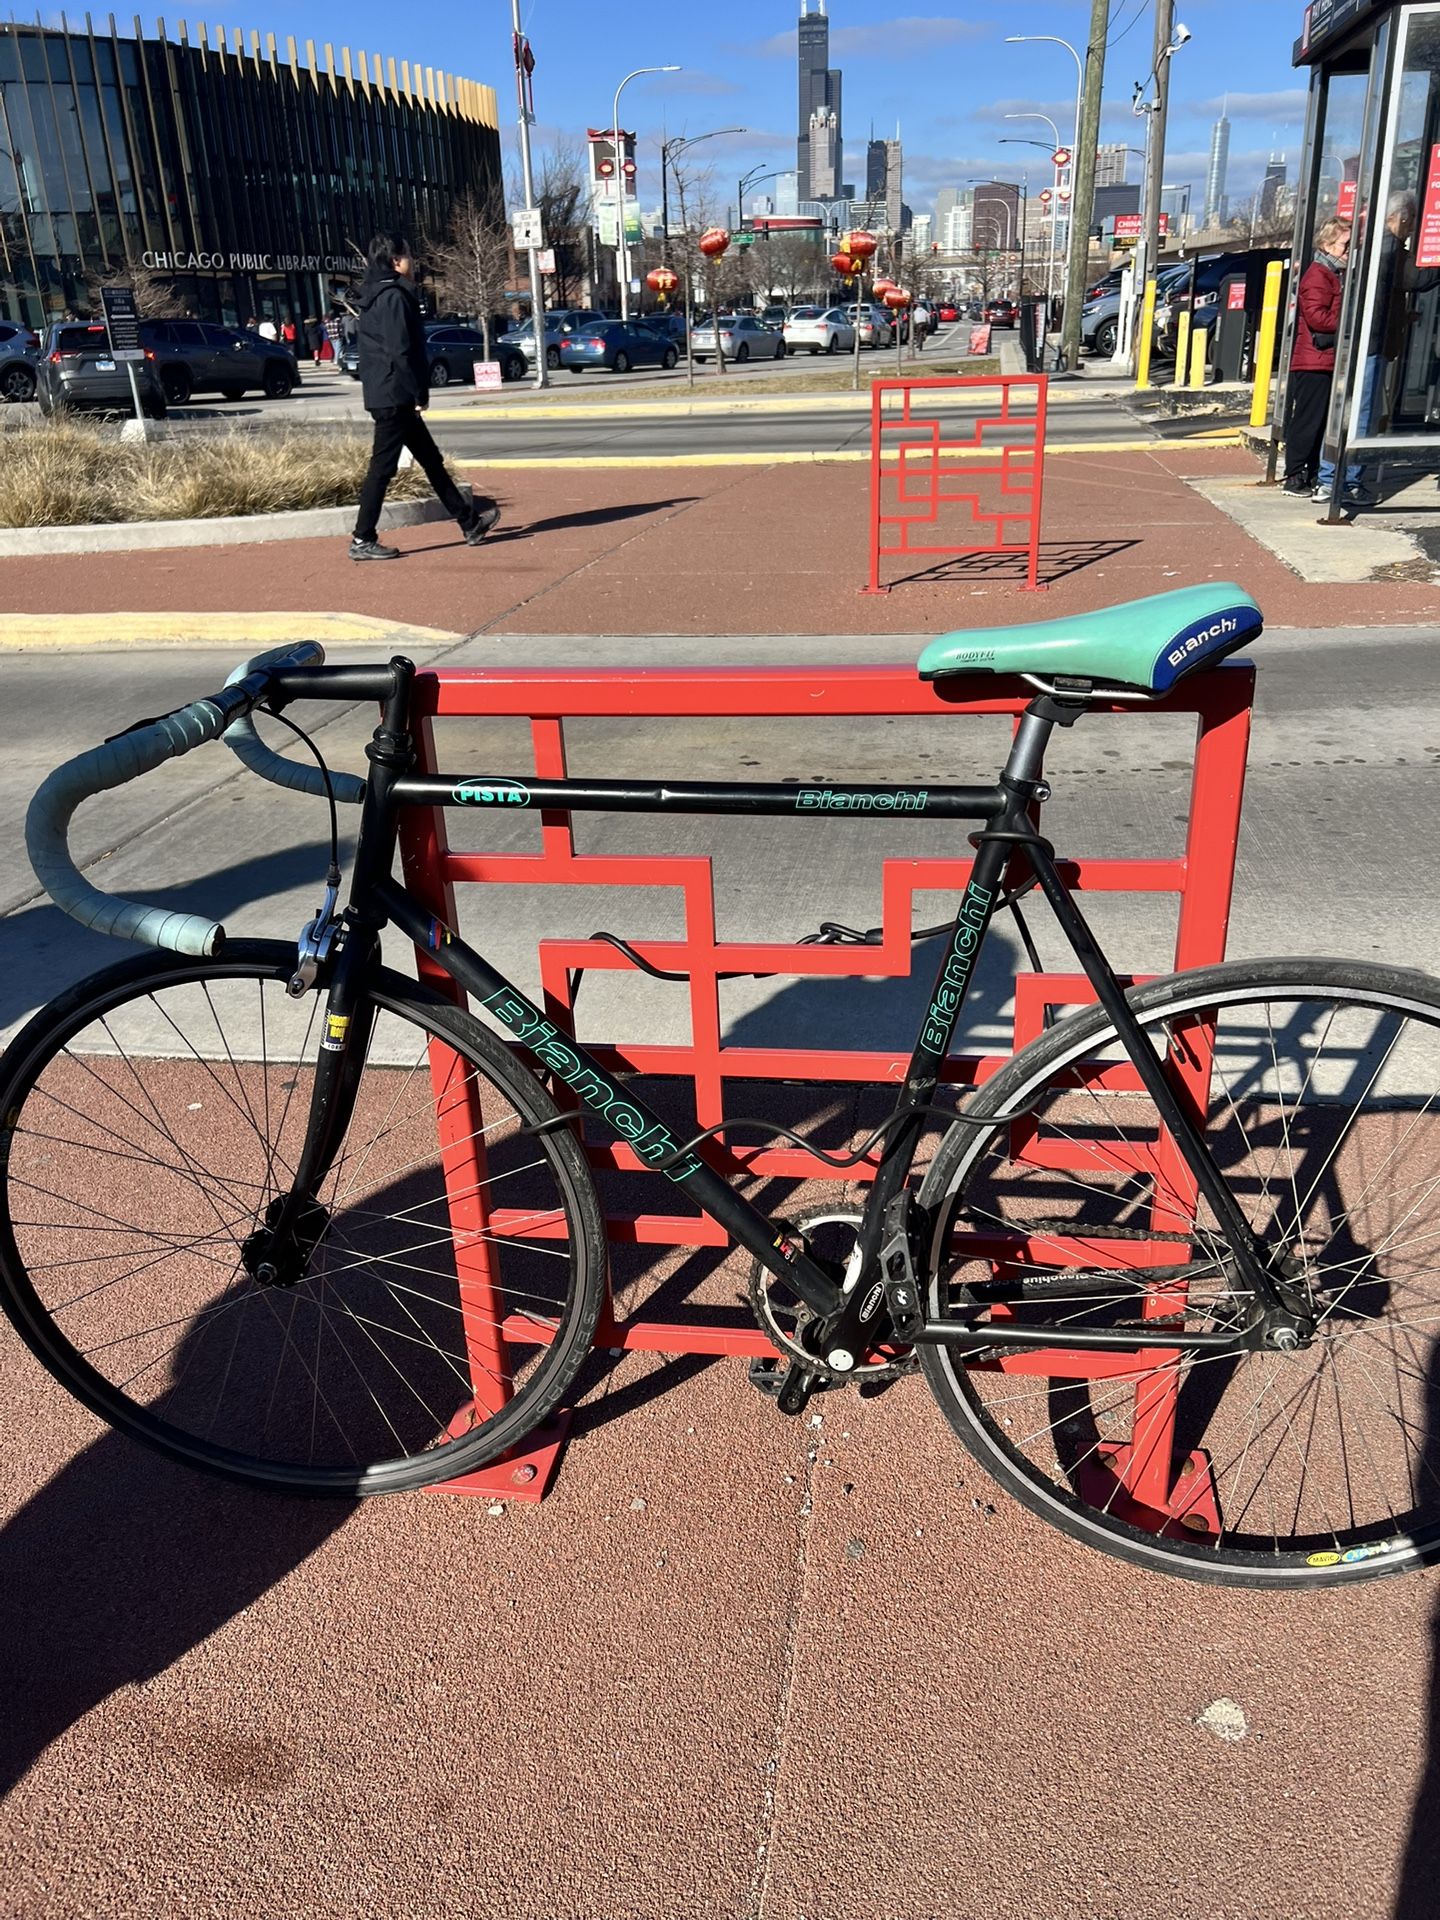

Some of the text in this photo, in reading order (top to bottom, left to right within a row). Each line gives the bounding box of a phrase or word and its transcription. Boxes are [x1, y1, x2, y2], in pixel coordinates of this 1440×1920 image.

[141, 251, 365, 271] CHICAGO PUBLIC LIBRARY CHINAT
[1167, 616, 1238, 668] Bianchi
[460, 786, 523, 803] PISTA
[796, 790, 928, 811] Bianchi
[920, 880, 993, 1056] Bianchi
[482, 986, 703, 1182] Bianchi
[861, 1285, 883, 1320] Bianchi
[533, 1311, 598, 1417] SERFAS
[1311, 1554, 1336, 1564] MAVIC
